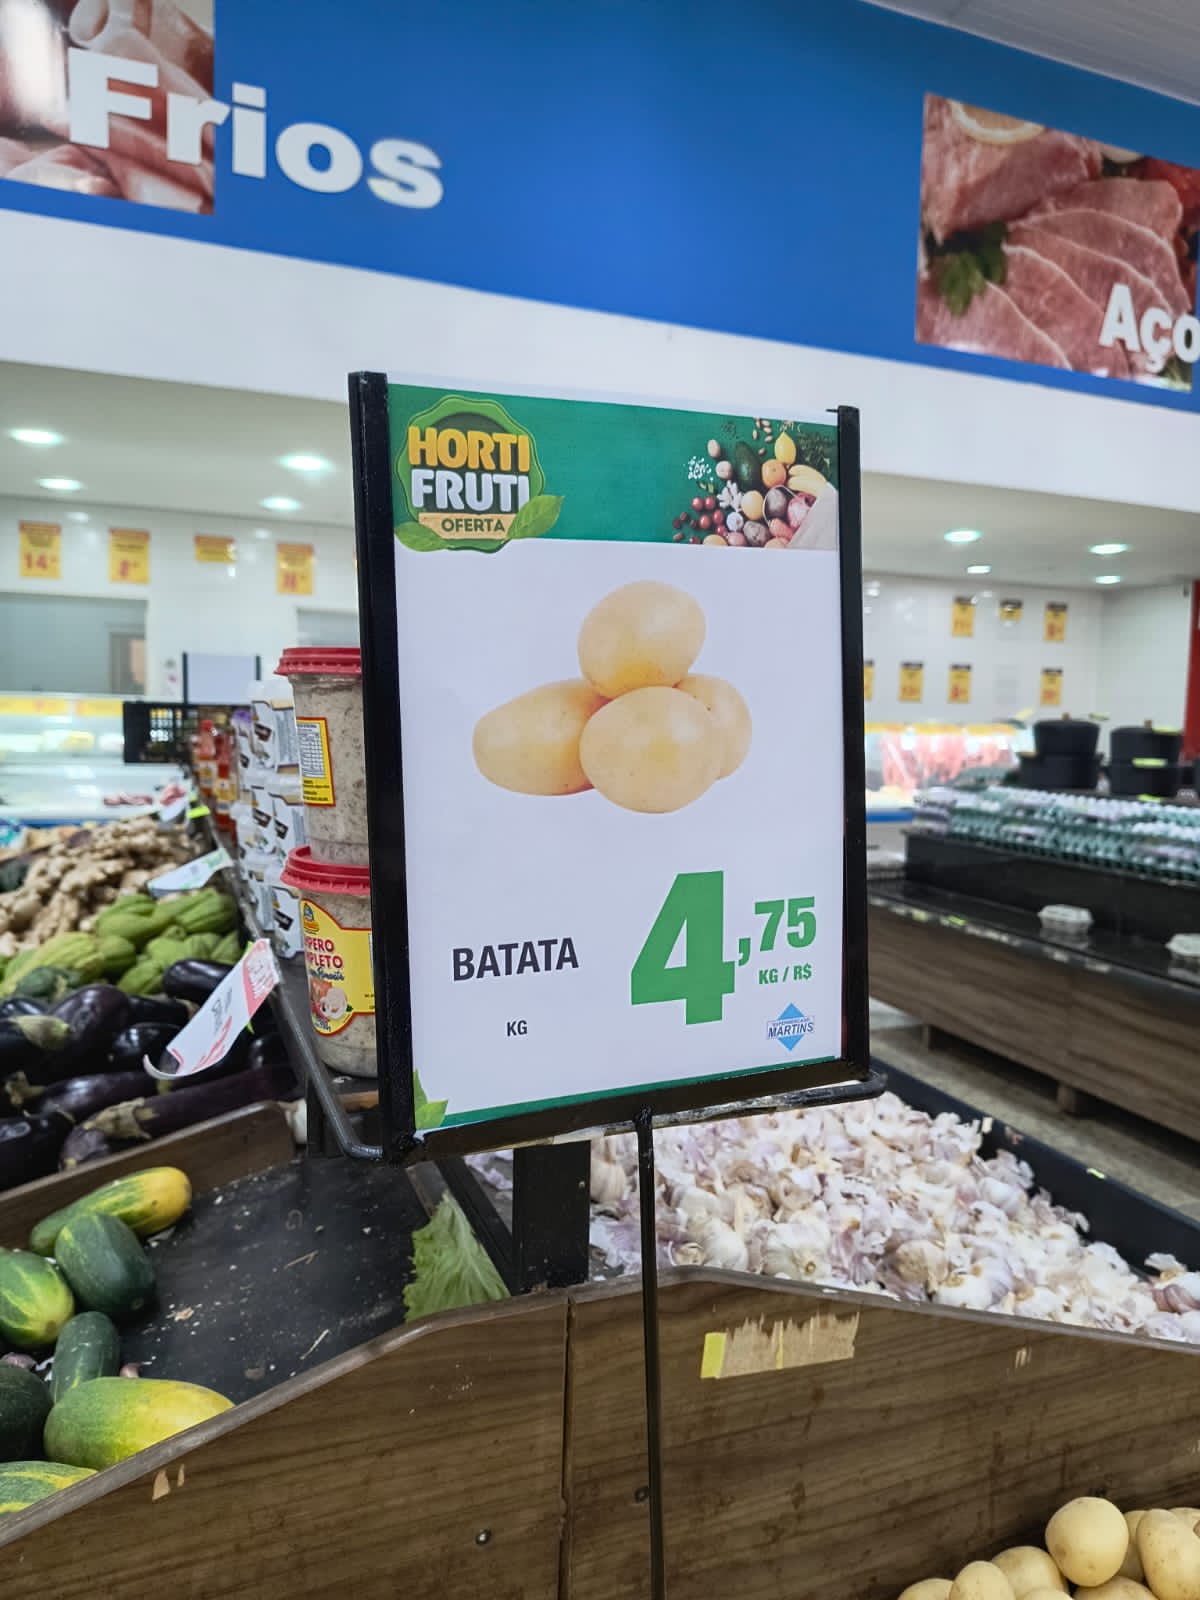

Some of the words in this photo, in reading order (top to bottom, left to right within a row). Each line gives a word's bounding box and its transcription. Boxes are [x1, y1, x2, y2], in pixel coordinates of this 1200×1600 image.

[68, 47, 444, 209] Frios
[407, 426, 530, 472] HORTI
[411, 468, 530, 512] FRUTI
[441, 518, 505, 532] OFERTA
[452, 937, 579, 981] BATATA
[758, 969, 779, 985] KG
[782, 966, 789, 982] /
[793, 962, 812, 980] R$
[507, 1020, 528, 1036] KG
[768, 1022, 814, 1038] MARTINS
